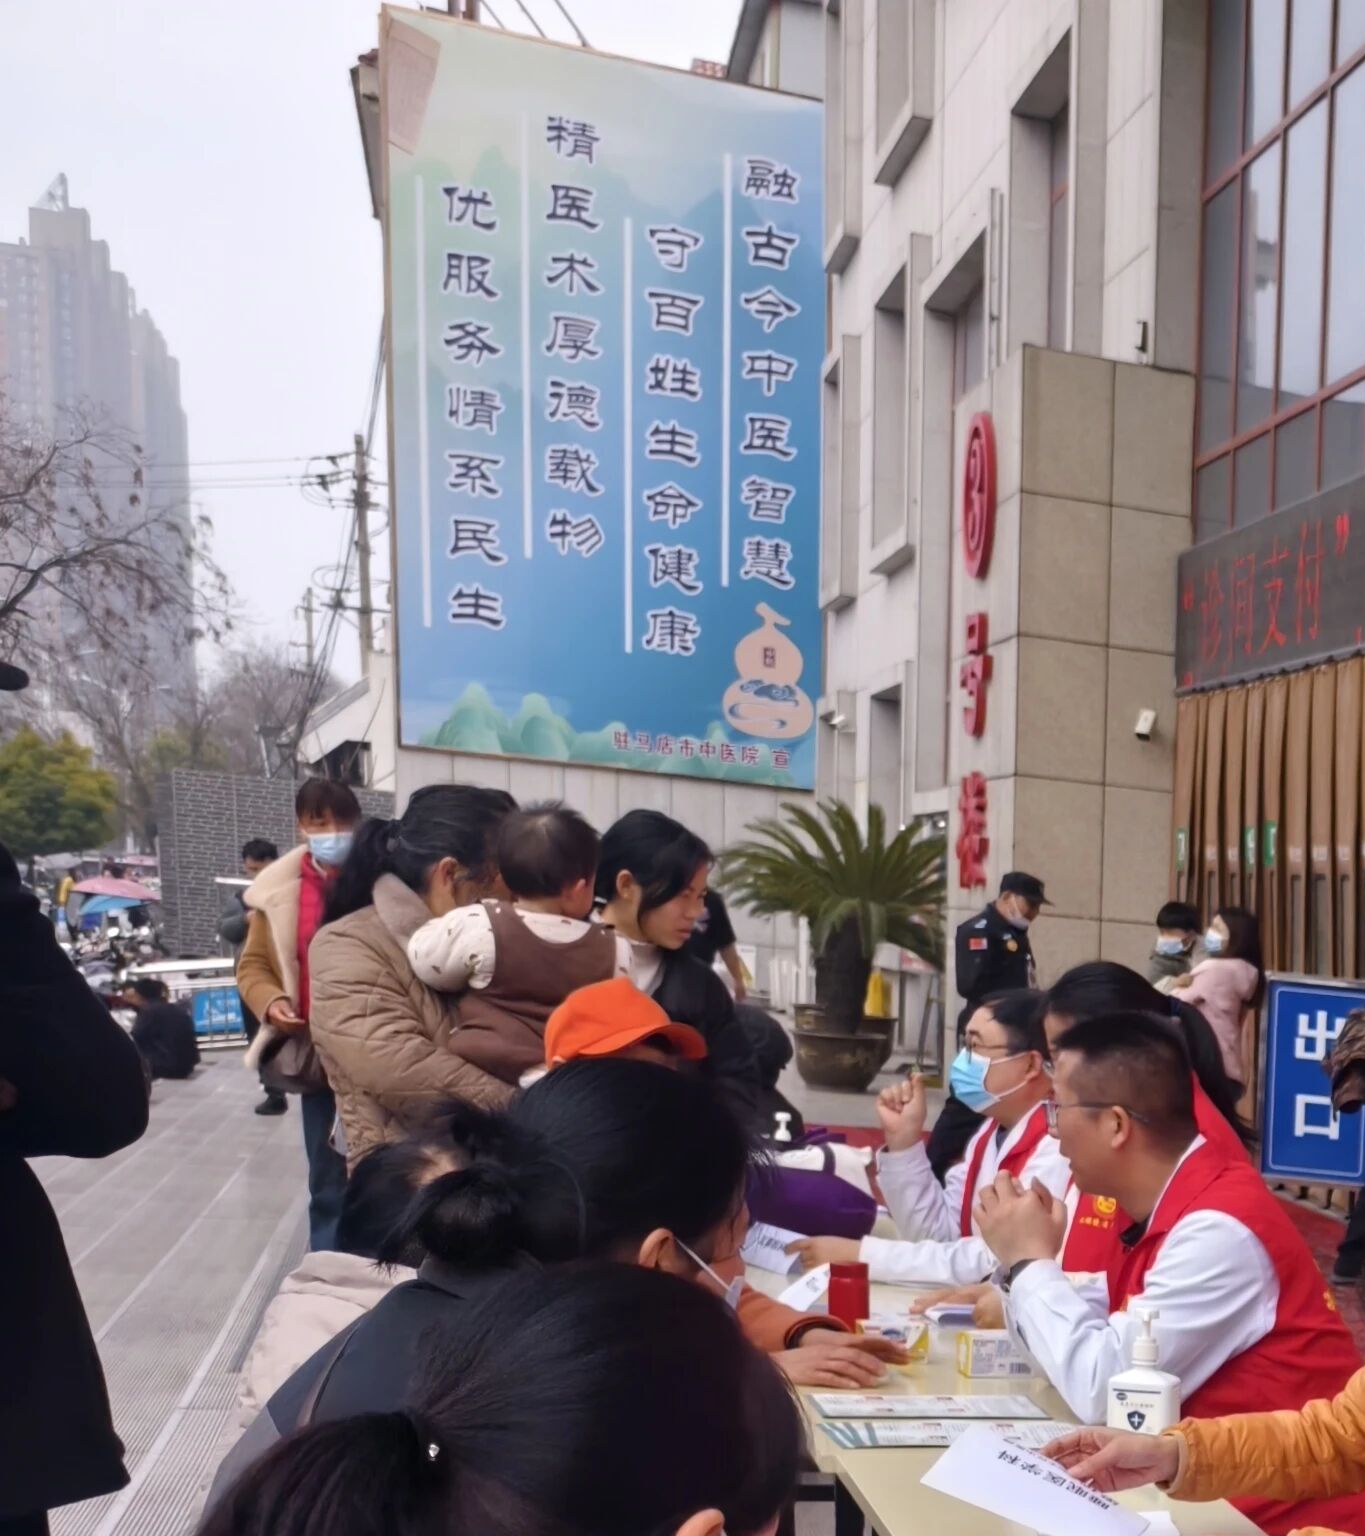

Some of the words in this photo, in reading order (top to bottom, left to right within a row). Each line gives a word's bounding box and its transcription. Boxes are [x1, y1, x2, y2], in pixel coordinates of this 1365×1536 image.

[442, 185, 503, 628] 优服务情系民生
[545, 115, 604, 558] 精医术厚德载物
[645, 226, 702, 655] 守百姓生命健康
[743, 157, 798, 590] 融古今中医智慧
[613, 731, 759, 764] 驻马店市中医院
[771, 748, 791, 769] 宣
[1294, 1010, 1347, 1140] 出口
